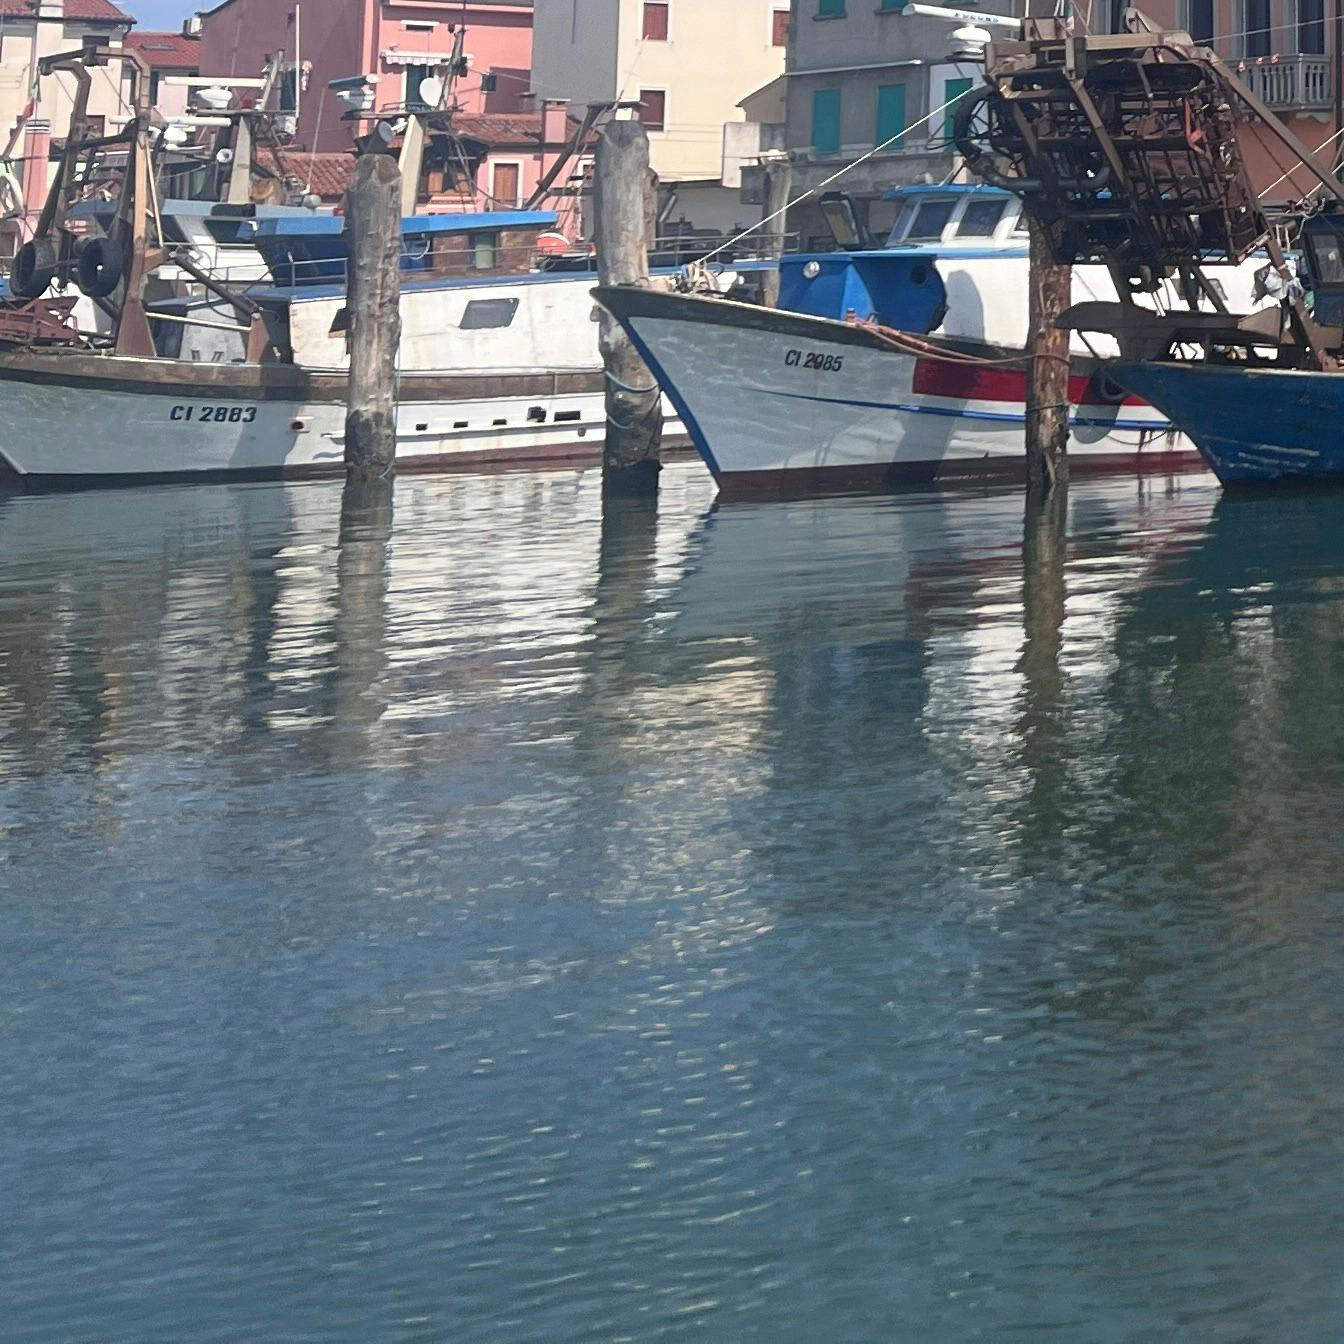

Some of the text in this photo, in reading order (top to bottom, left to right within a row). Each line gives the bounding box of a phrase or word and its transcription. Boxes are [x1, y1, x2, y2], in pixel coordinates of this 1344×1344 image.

[785, 349, 801, 366] CI
[170, 405, 258, 423] CI 2883
